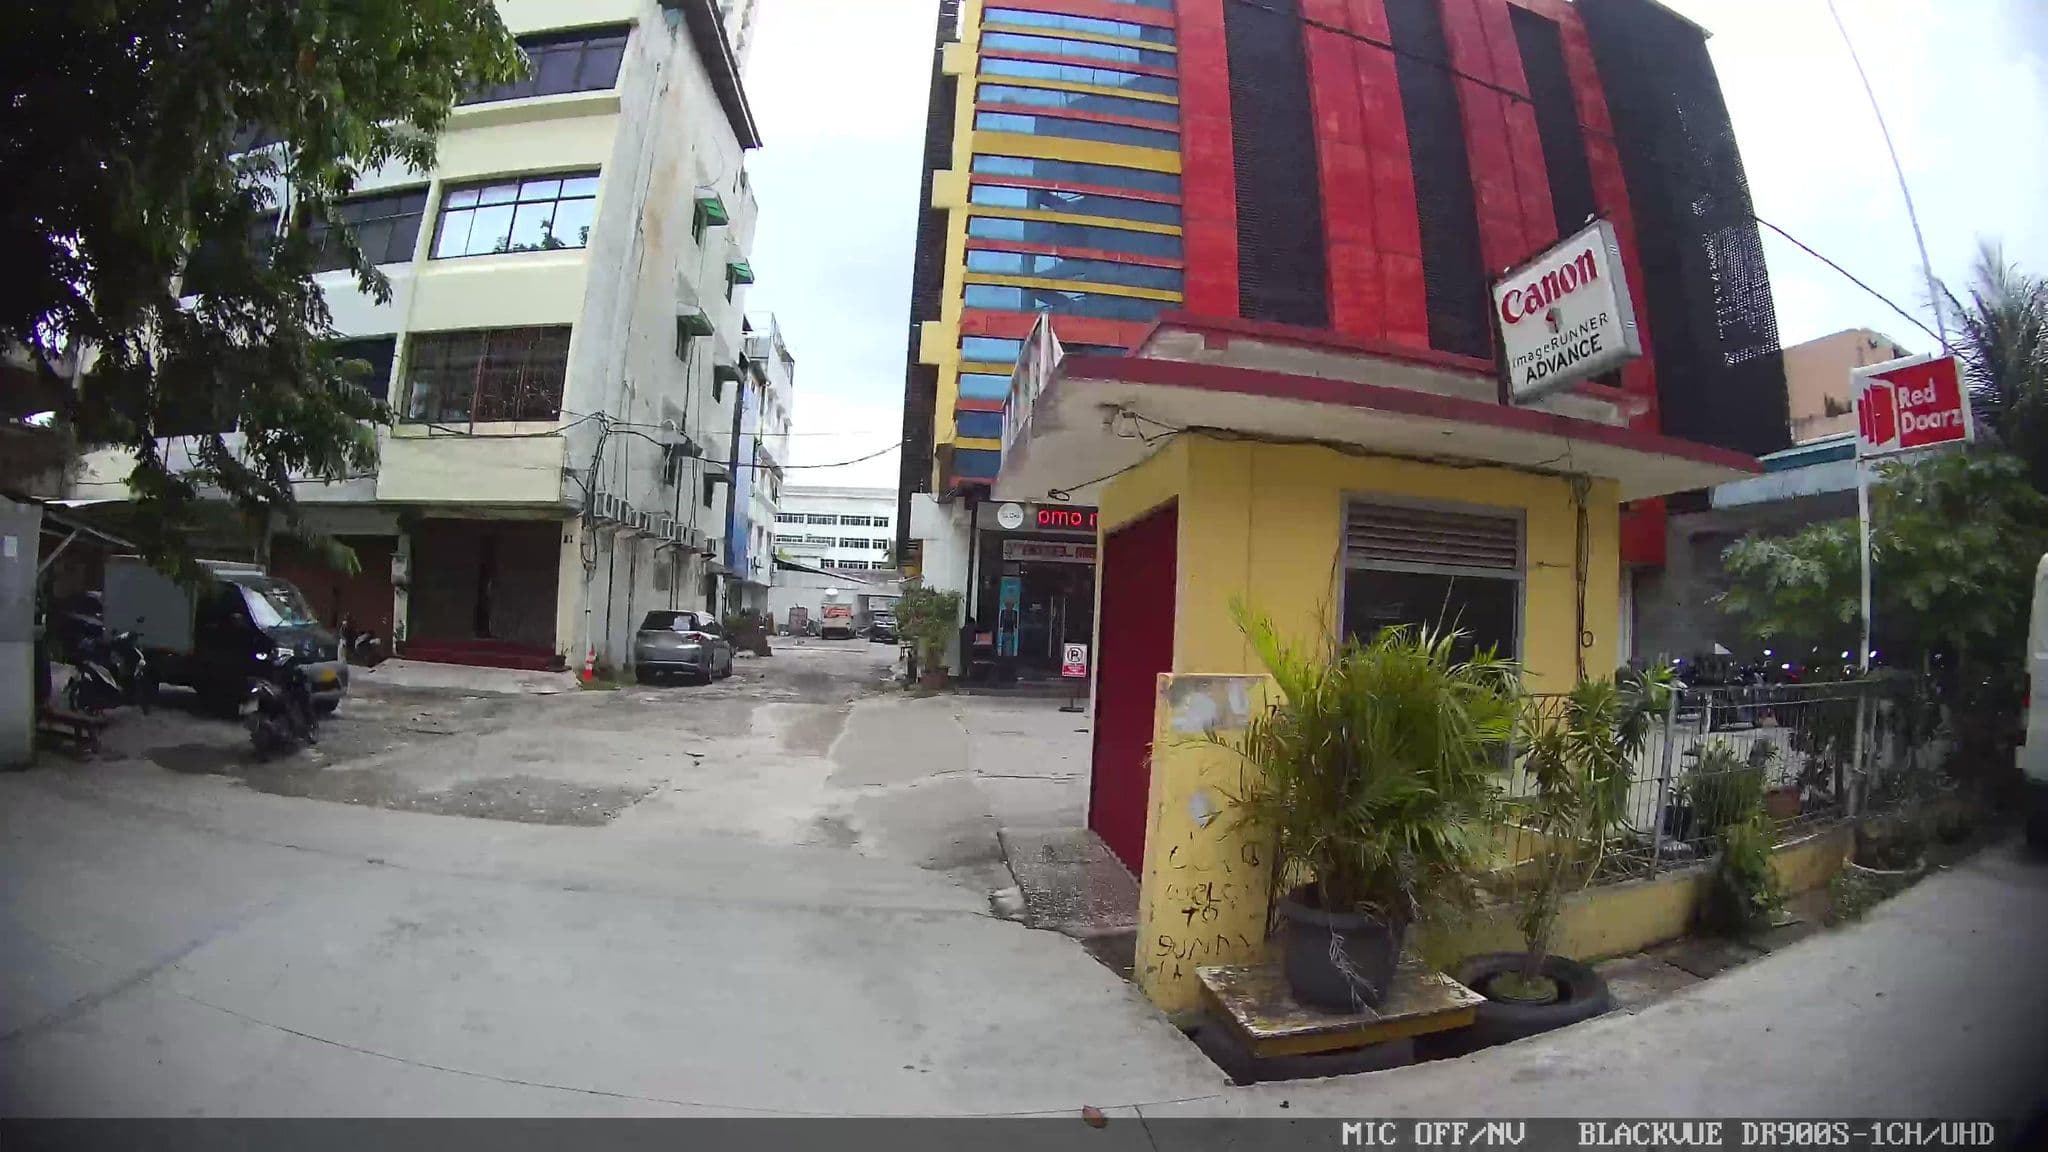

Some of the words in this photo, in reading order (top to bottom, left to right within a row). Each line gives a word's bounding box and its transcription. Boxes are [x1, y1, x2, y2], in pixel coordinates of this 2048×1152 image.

[1501, 249, 1599, 325] Canon
[1512, 312, 1609, 369] imageRUNNER
[1526, 333, 1603, 385] ADVANCE
[1898, 377, 1937, 409] Red
[1038, 510, 1083, 526] omo
